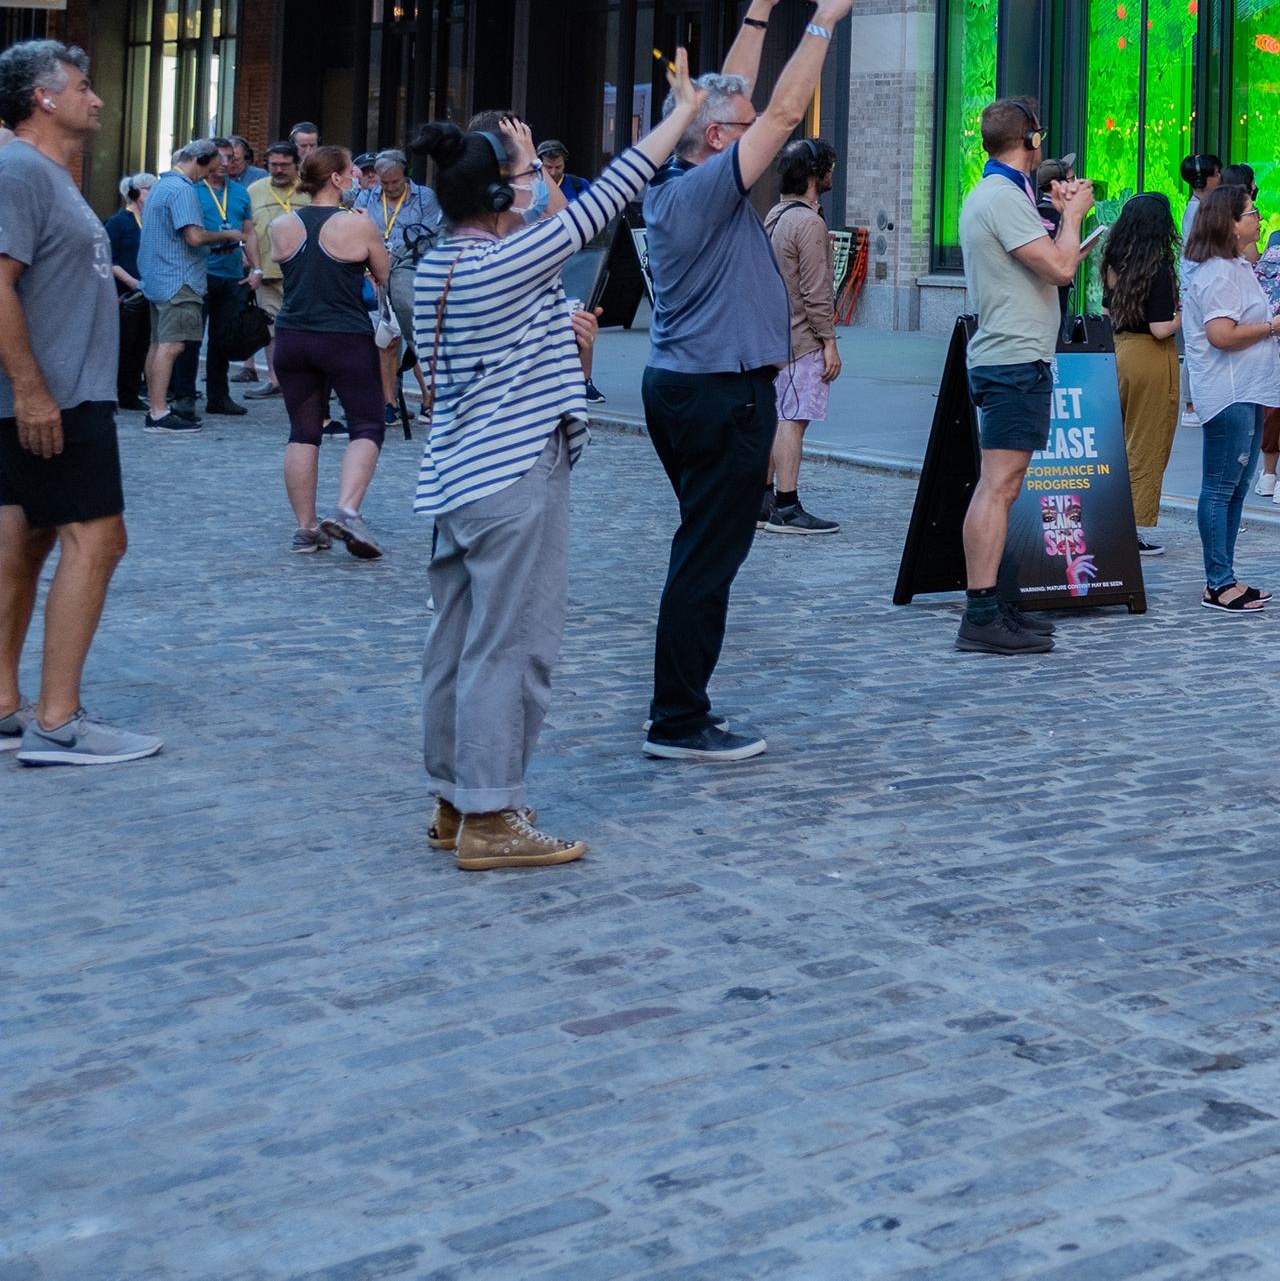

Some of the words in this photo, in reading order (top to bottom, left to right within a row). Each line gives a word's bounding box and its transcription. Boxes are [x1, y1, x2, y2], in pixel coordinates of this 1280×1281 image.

[1025, 465, 1094, 478] FORMANCE
[1097, 464, 1110, 474] IN
[1027, 479, 1090, 490] PROGRESS
